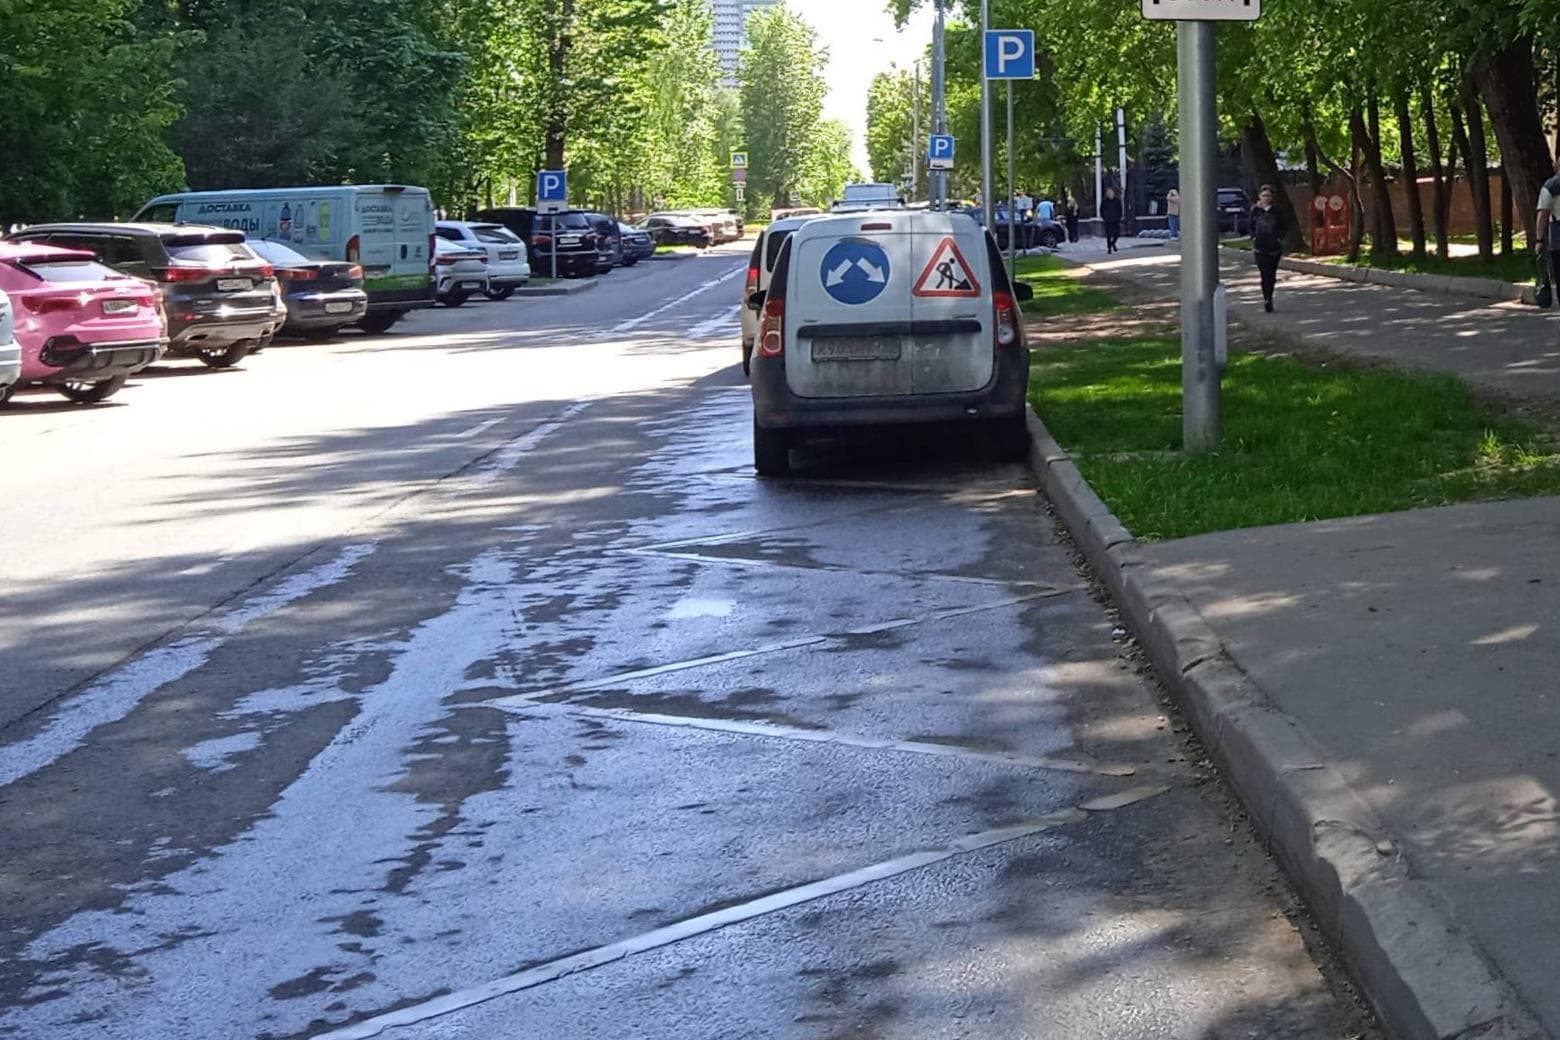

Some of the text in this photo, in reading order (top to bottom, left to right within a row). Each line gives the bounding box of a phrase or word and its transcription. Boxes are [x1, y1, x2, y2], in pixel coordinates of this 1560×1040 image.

[998, 36, 1025, 73] P
[935, 138, 949, 156] P
[543, 174, 559, 198] P
[198, 203, 252, 215] ДОСТАВКА
